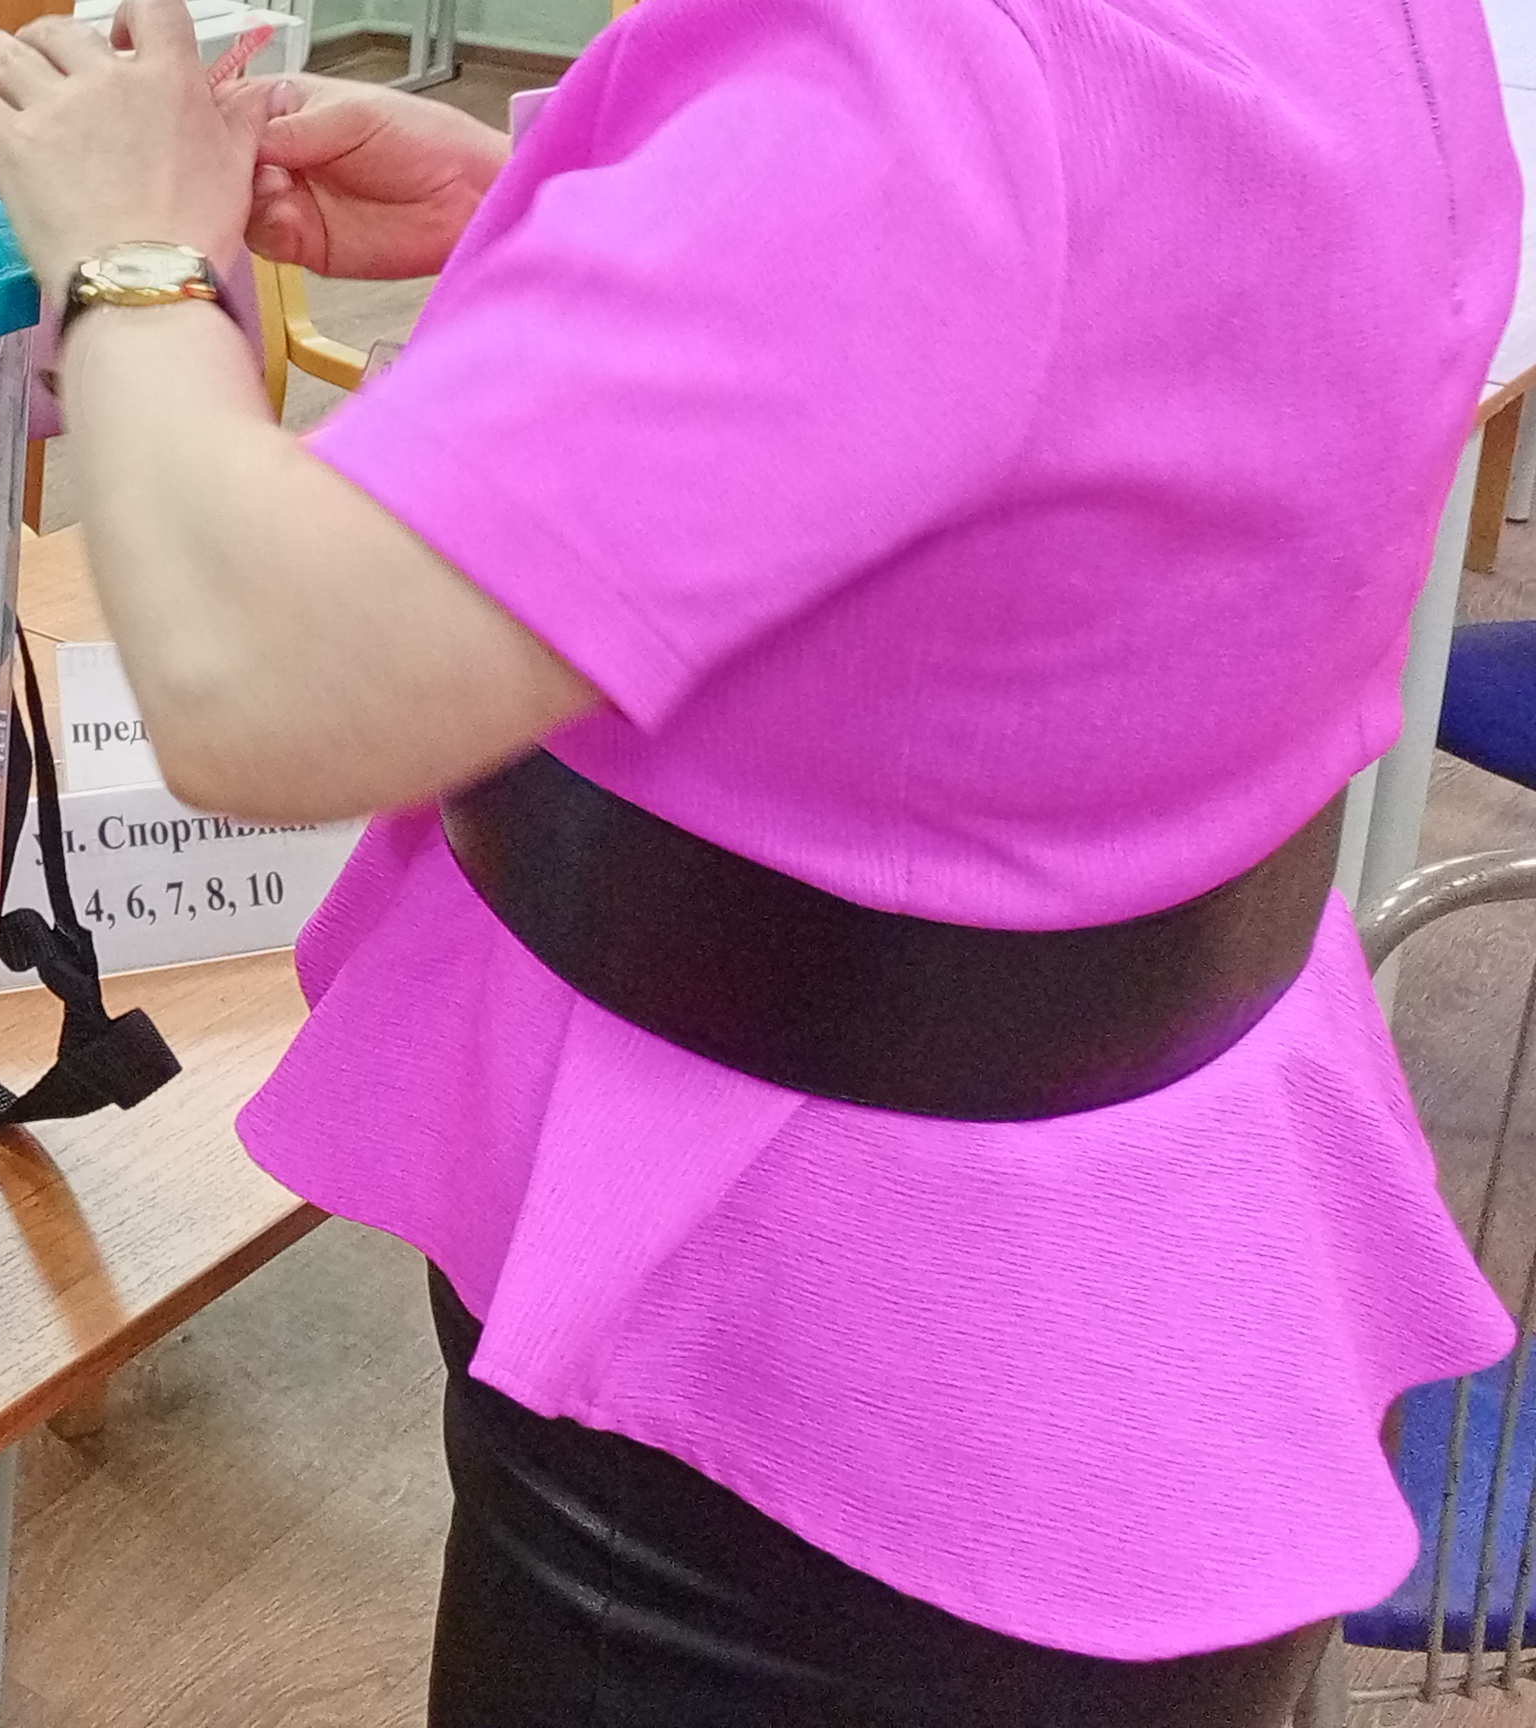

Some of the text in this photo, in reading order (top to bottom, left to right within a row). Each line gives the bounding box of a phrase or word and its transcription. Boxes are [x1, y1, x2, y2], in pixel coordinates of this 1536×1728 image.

[71, 719, 150, 751] пред
[84, 870, 284, 930] 4, 6, 7, 8, 10
